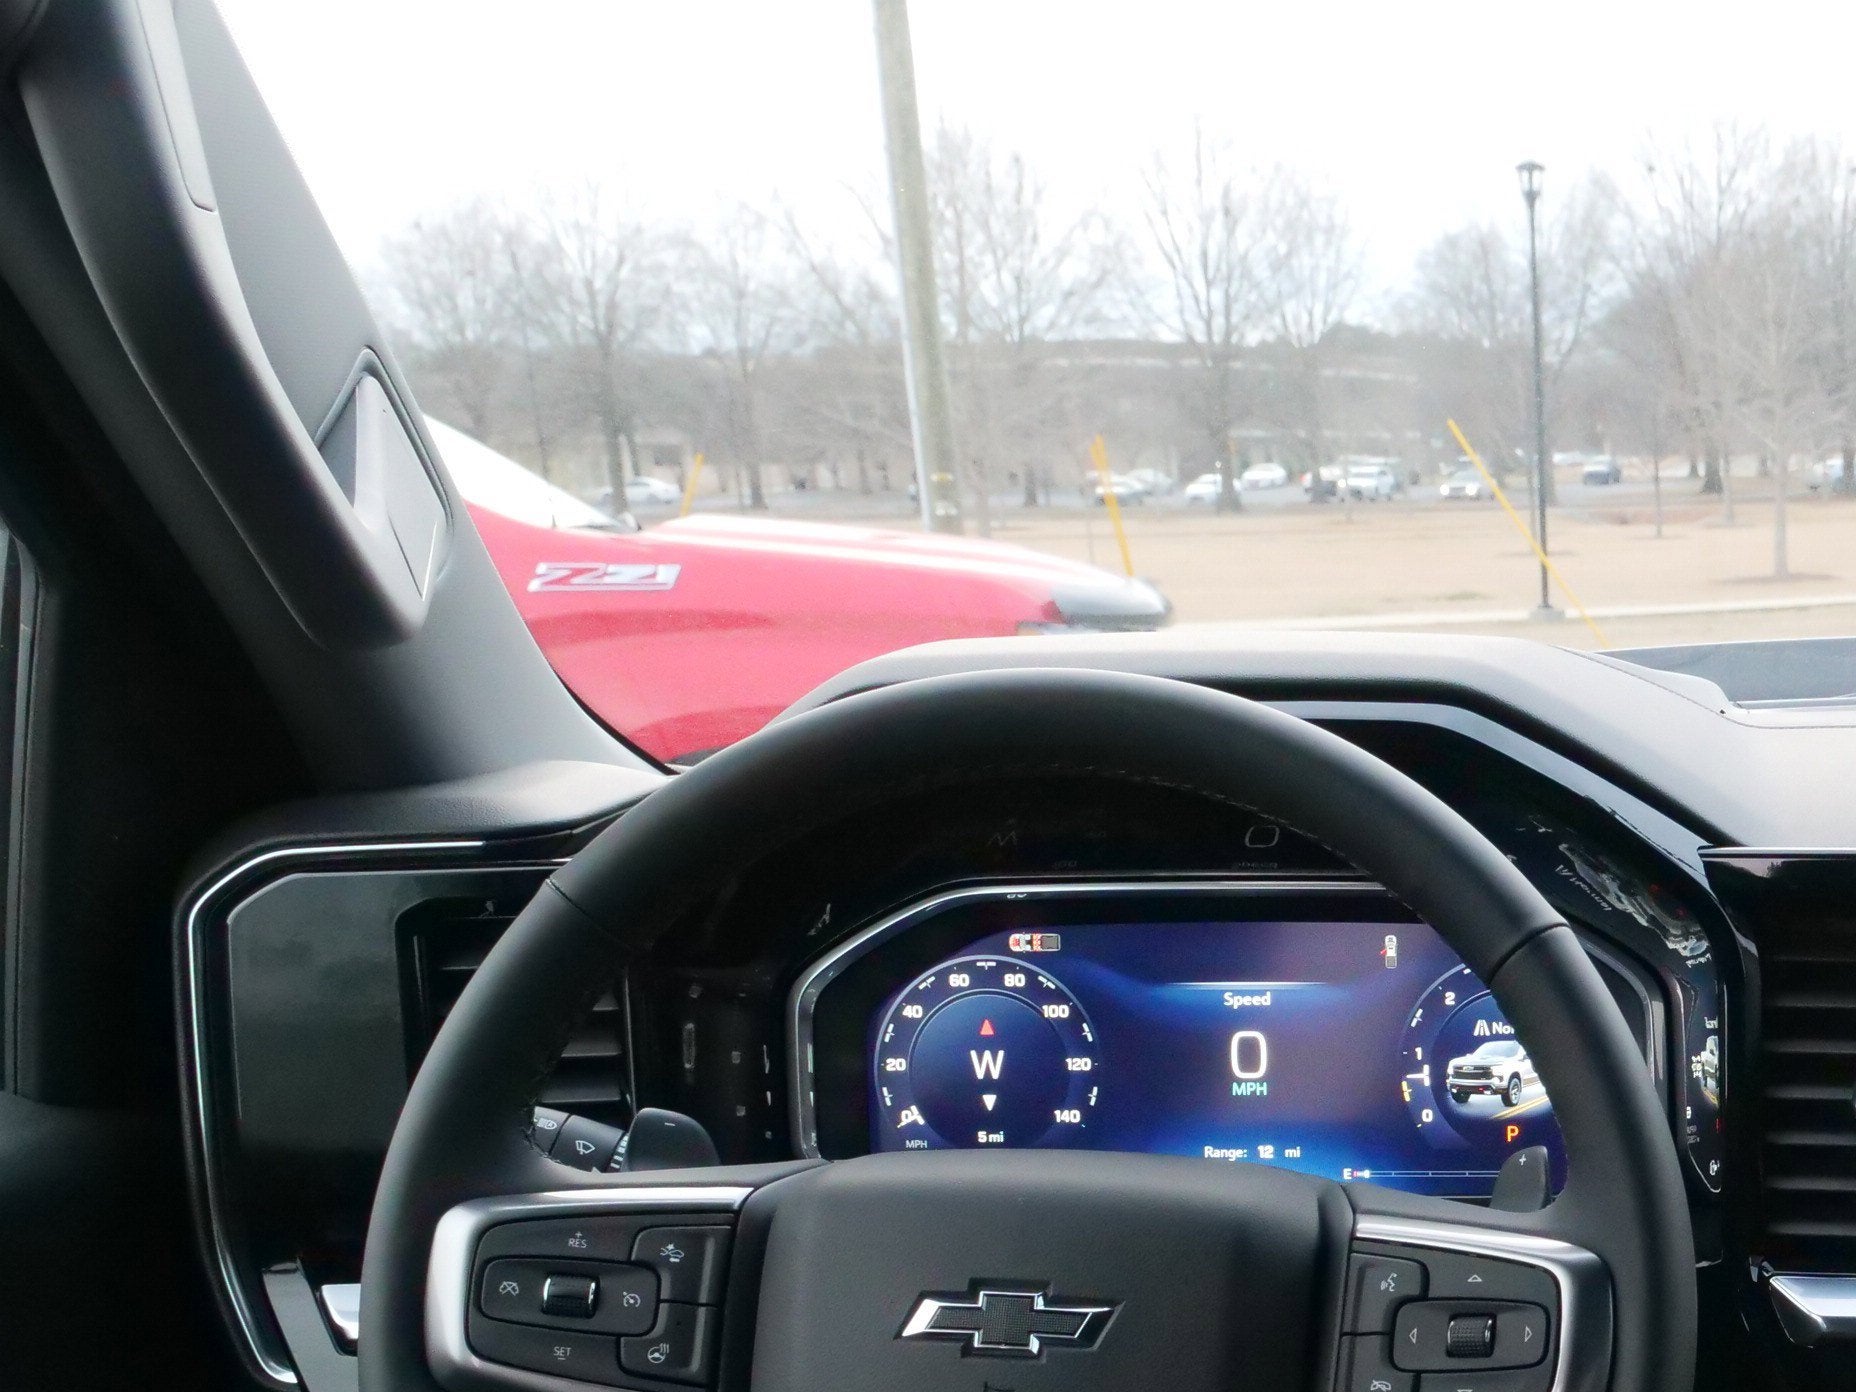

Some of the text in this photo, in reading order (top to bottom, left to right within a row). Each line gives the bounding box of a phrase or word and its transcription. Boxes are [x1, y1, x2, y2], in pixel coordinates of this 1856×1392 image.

[949, 974, 970, 987] 60
[1004, 974, 1026, 987] 80
[1223, 991, 1271, 1009] Speed
[1444, 992, 1456, 1005] 2
[902, 1005, 923, 1018] 40
[1042, 1004, 1069, 1018] 100
[1231, 1030, 1267, 1079] 0
[1415, 1047, 1423, 1060] 1
[886, 1058, 906, 1071] 20
[970, 1050, 1005, 1080] W
[1066, 1058, 1091, 1071] 120
[1232, 1082, 1267, 1096] MPH
[1054, 1110, 1080, 1123] 140
[1422, 1109, 1433, 1122] 0
[978, 1131, 1004, 1143] 5 mi
[1506, 1125, 1520, 1142] P
[906, 1140, 928, 1149] MPH
[1204, 1145, 1301, 1161] Range: 12 mi
[1343, 1168, 1352, 1179] E
[568, 1238, 587, 1249] RES
[553, 1346, 572, 1357] SET
